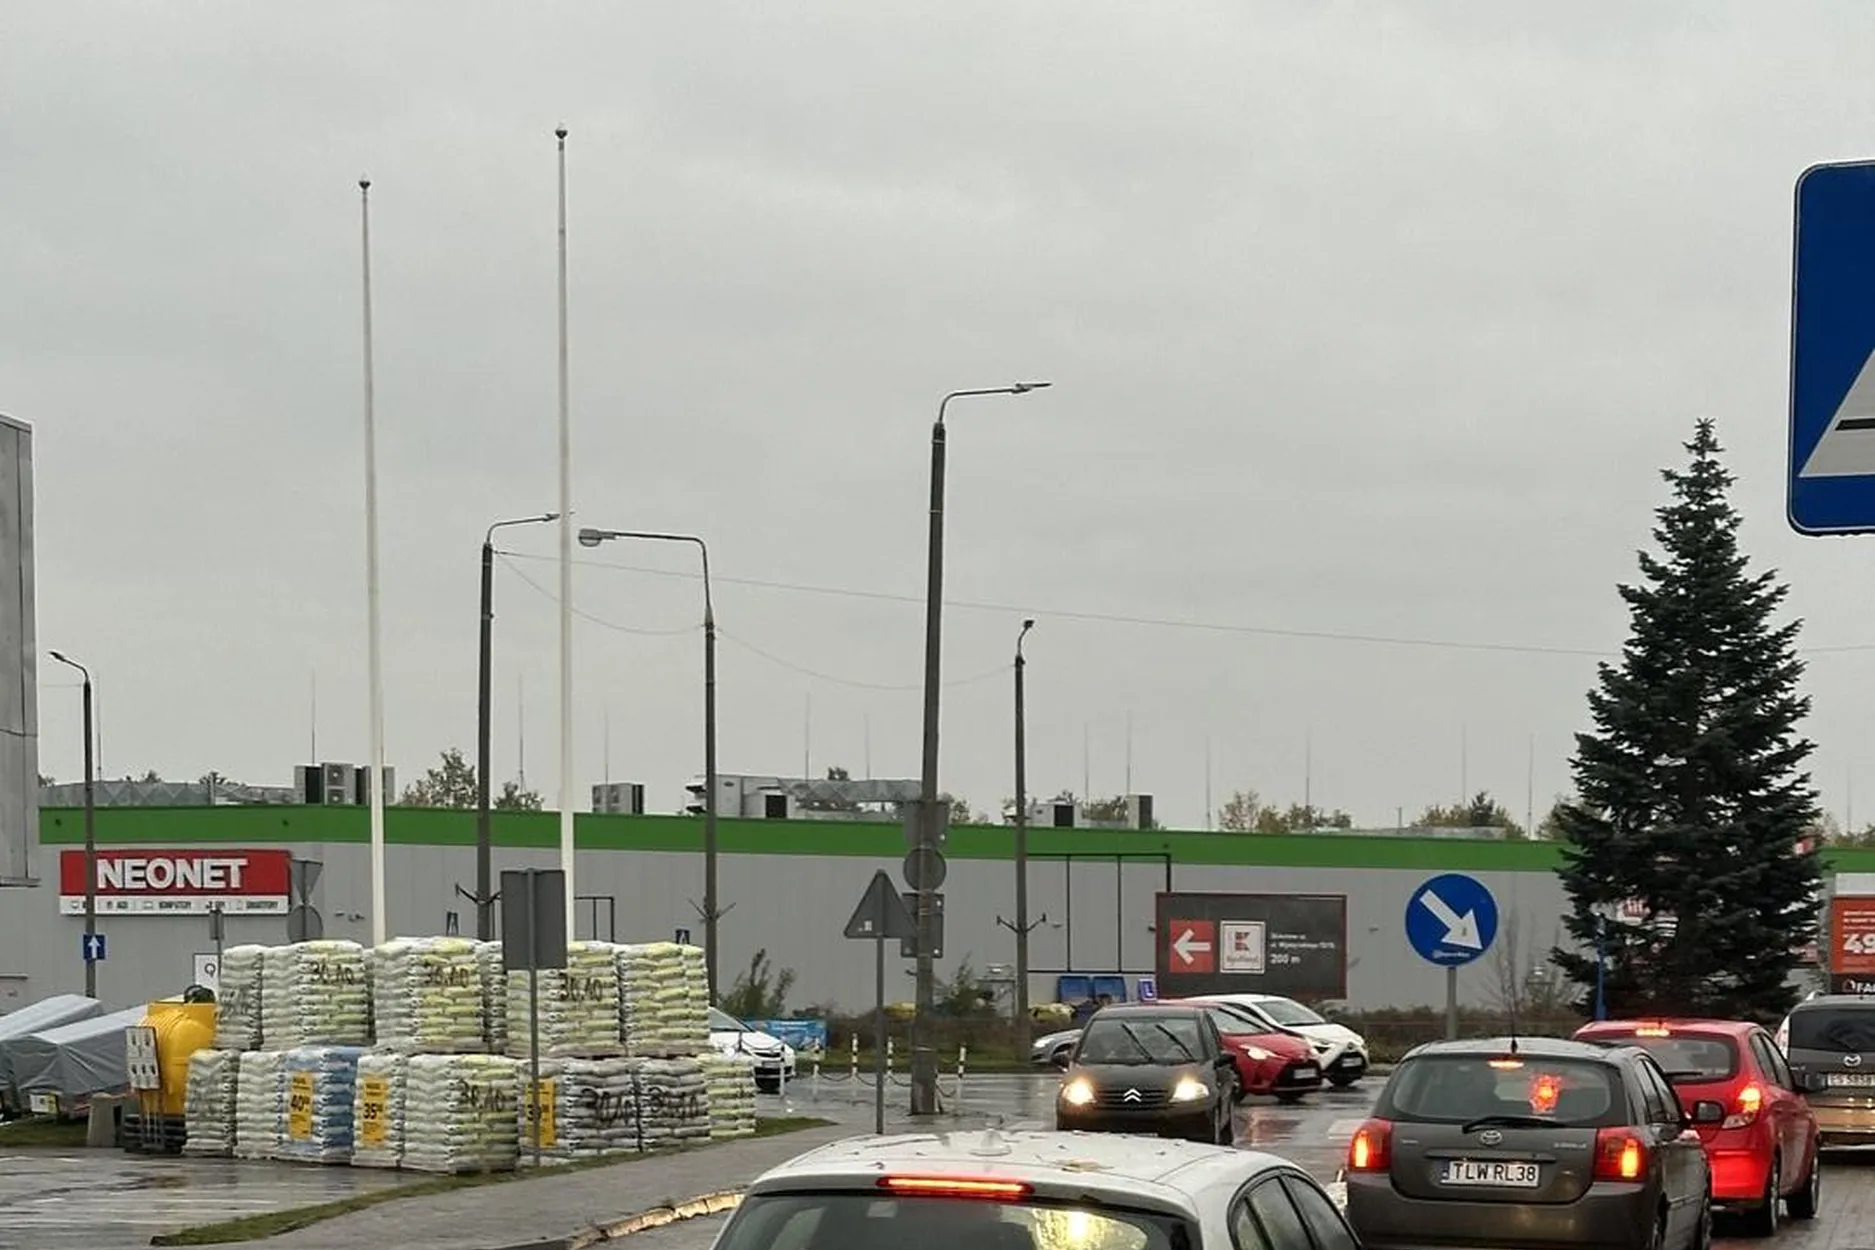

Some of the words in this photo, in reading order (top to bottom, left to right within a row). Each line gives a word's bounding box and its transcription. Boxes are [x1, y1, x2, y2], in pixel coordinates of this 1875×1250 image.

[96, 858, 248, 889] NEONET
[1452, 1162, 1491, 1180] TLW
[1493, 1164, 1537, 1182] RL38
